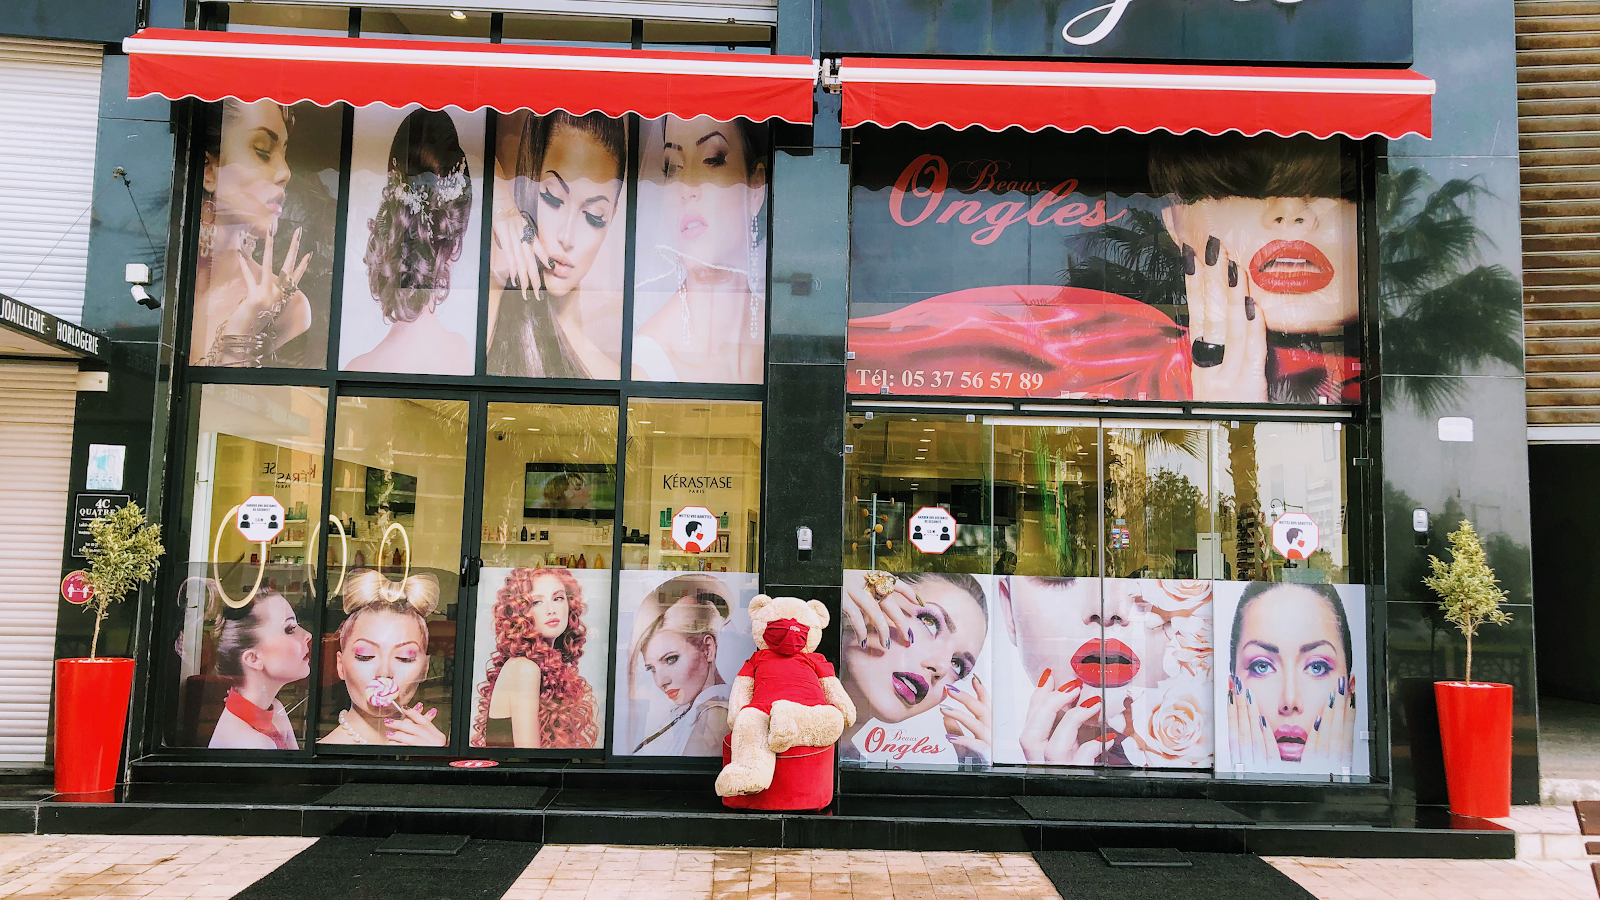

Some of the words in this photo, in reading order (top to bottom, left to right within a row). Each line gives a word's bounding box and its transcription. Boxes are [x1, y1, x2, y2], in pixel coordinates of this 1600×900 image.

[949, 158, 1048, 192] Beaux
[888, 153, 1127, 245] Ongles
[0, 298, 45, 334] JOAILLERIE
[56, 320, 100, 355] HORLOGERIE
[856, 369, 895, 388] Tél:
[901, 370, 925, 388] 05
[930, 370, 954, 388] 37
[960, 371, 984, 389] 56
[989, 372, 1013, 389] 57
[1019, 372, 1043, 390] 89
[663, 473, 732, 490] KÉRASTASE
[95, 498, 111, 509] 4C
[864, 726, 946, 760] Ongles
[886, 729, 918, 741] Beaux
